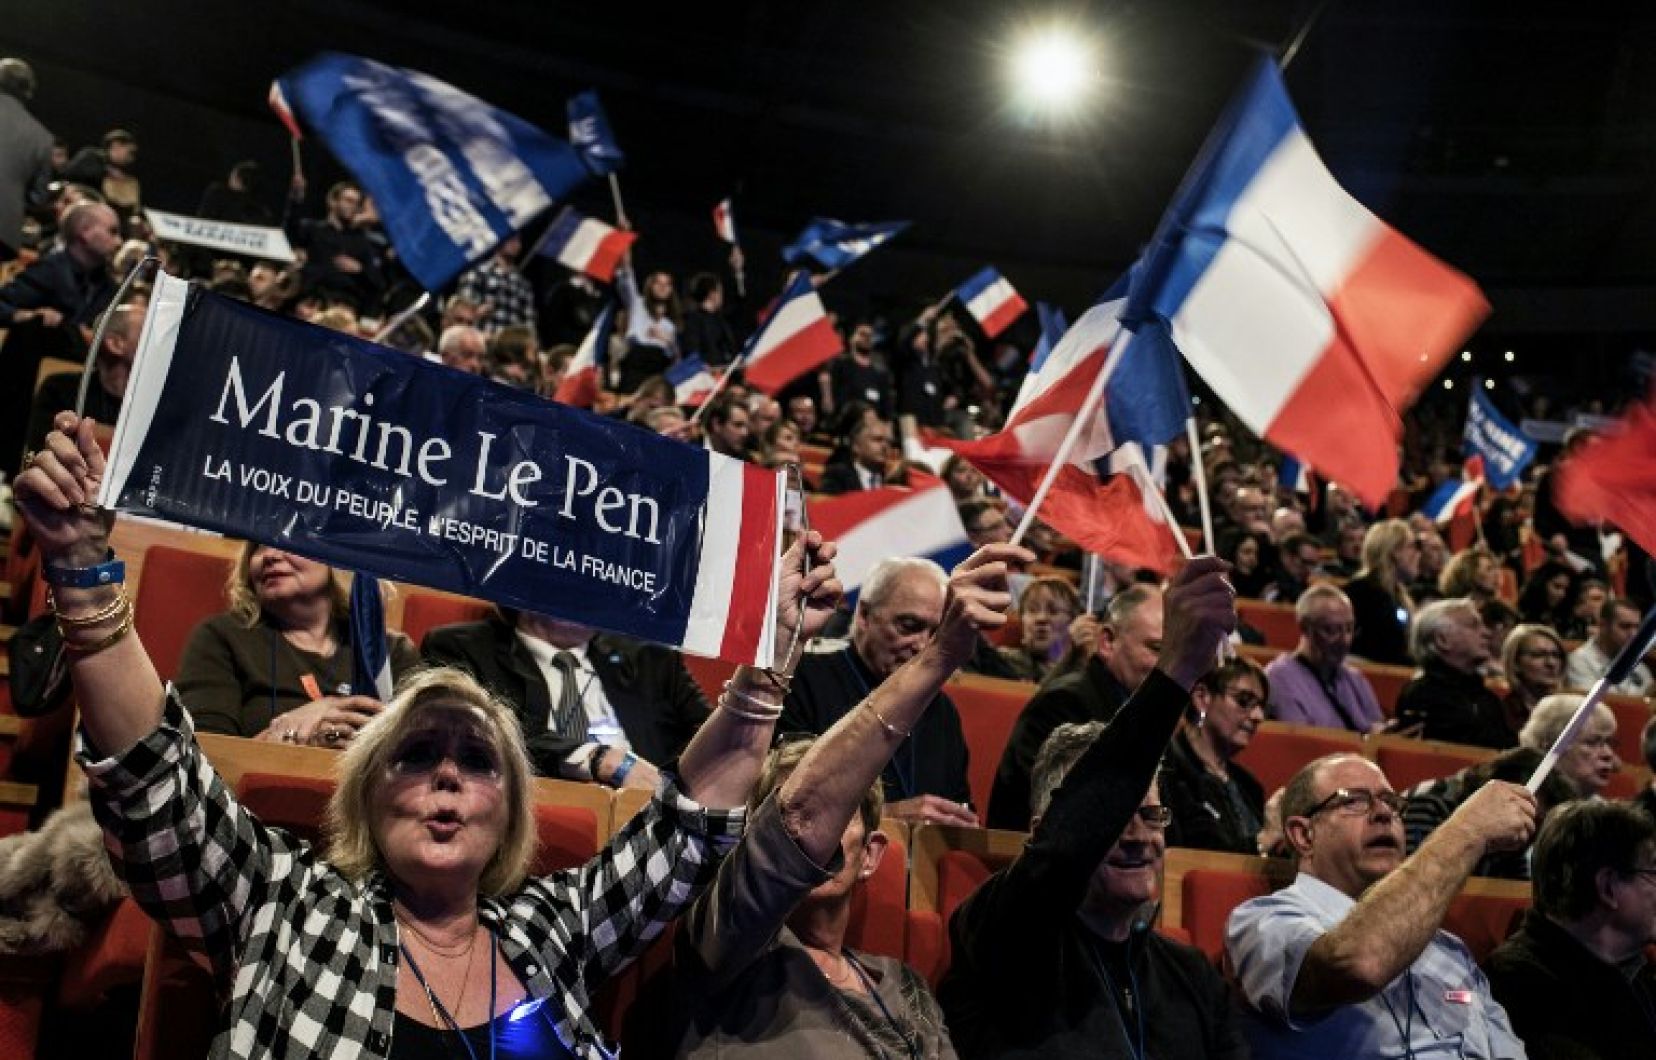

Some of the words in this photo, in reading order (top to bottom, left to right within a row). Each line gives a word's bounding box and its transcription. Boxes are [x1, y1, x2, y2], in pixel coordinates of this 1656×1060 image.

[203, 454, 232, 483] LA
[240, 463, 292, 499] VOIX
[296, 480, 331, 506] DU
[335, 489, 421, 535] PEUPLE,
[428, 515, 518, 552] L'ESPRIT
[521, 537, 549, 564] DE
[553, 545, 577, 572] LA
[581, 554, 656, 593] FRANCE
[208, 355, 452, 487] Marine
[469, 431, 542, 507] Le
[558, 454, 661, 545] Pen
